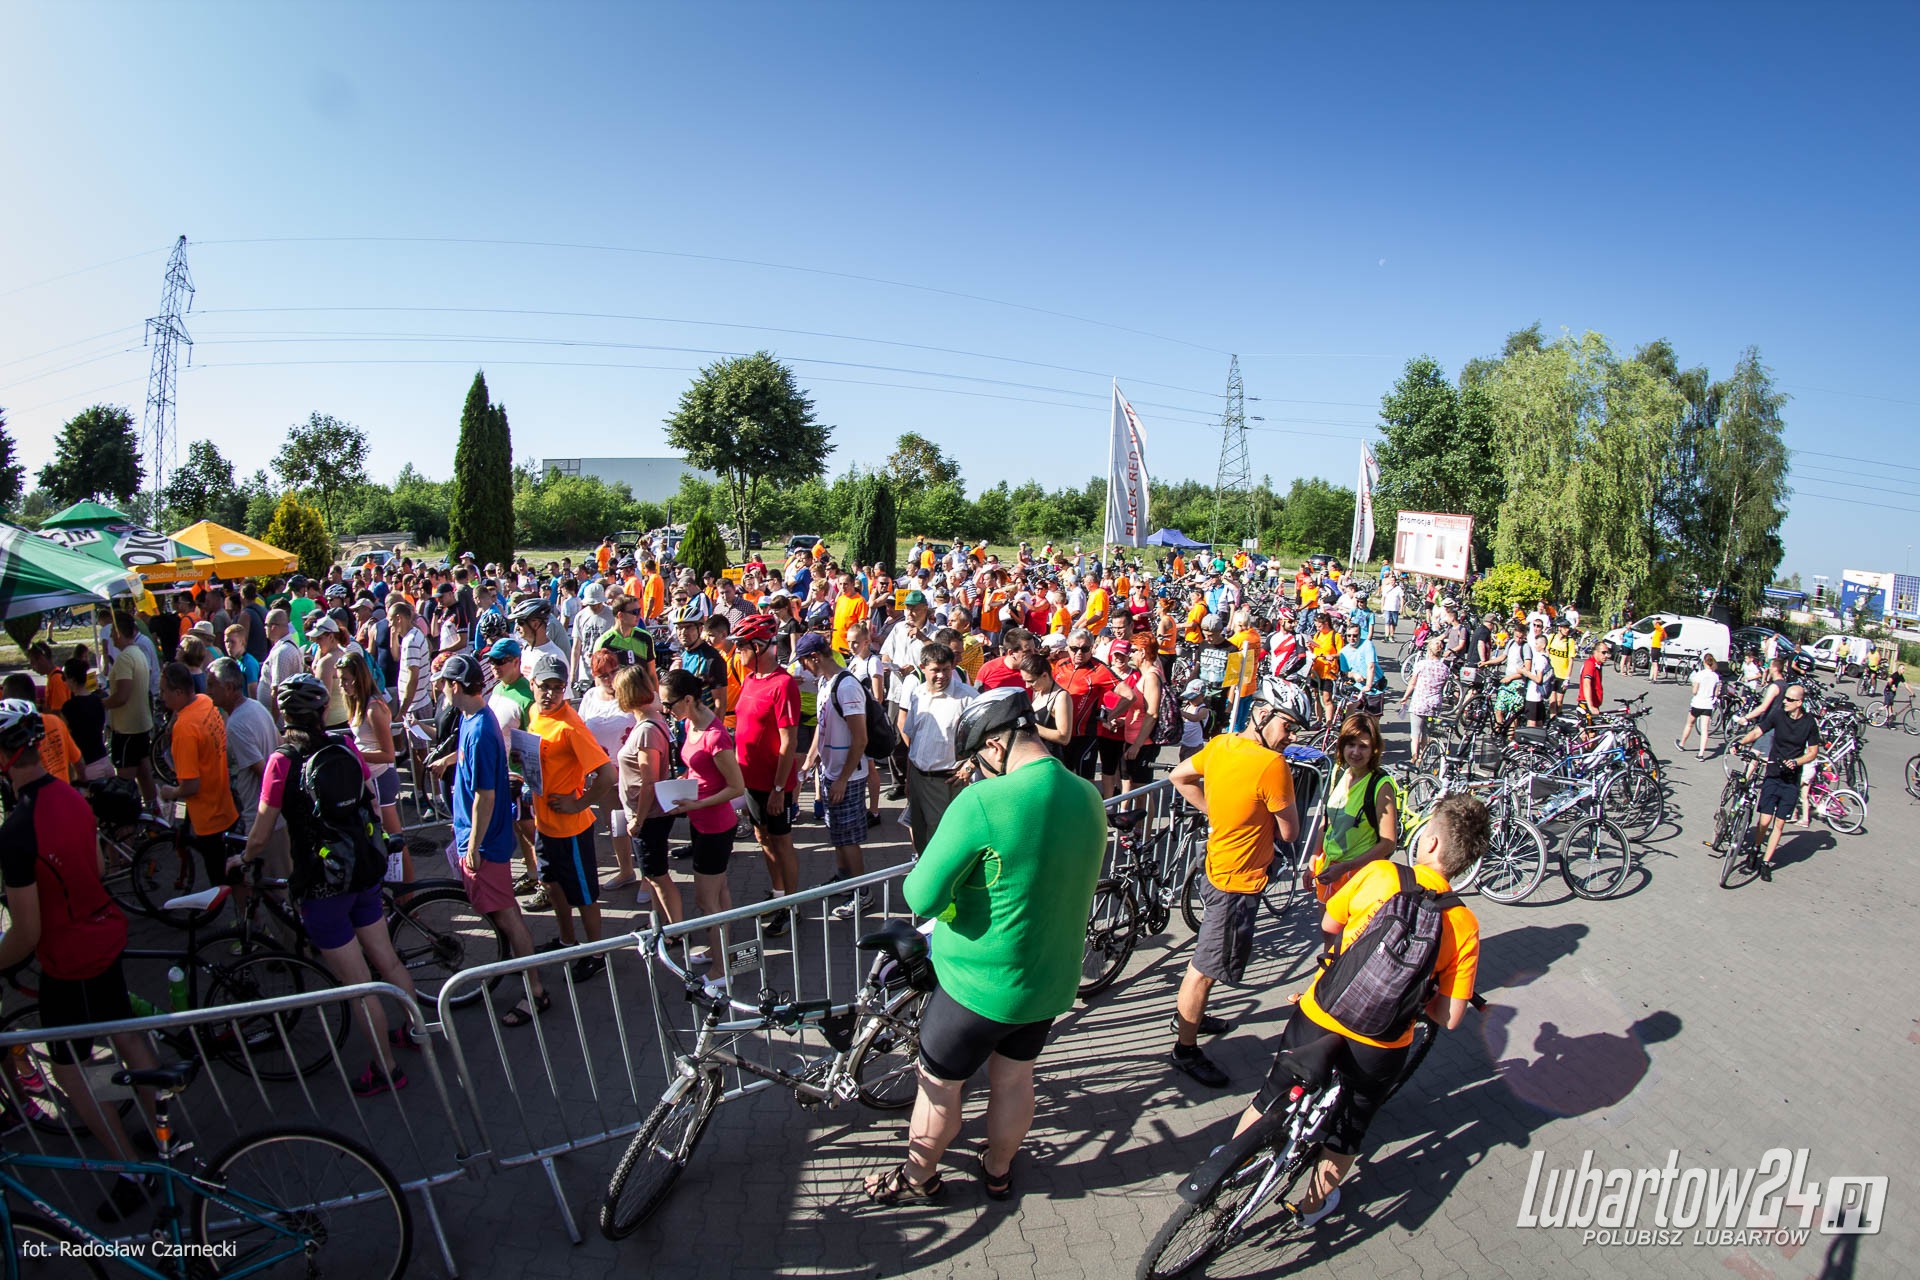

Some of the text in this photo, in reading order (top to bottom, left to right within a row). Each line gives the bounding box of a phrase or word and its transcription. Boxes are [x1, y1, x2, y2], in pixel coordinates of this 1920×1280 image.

[1128, 451, 1139, 482] RED
[1125, 488, 1138, 536] BLACK
[627, 649, 635, 664] 9
[1201, 648, 1228, 660] STAR
[1200, 656, 1227, 668] WARS
[737, 946, 757, 957] SLS
